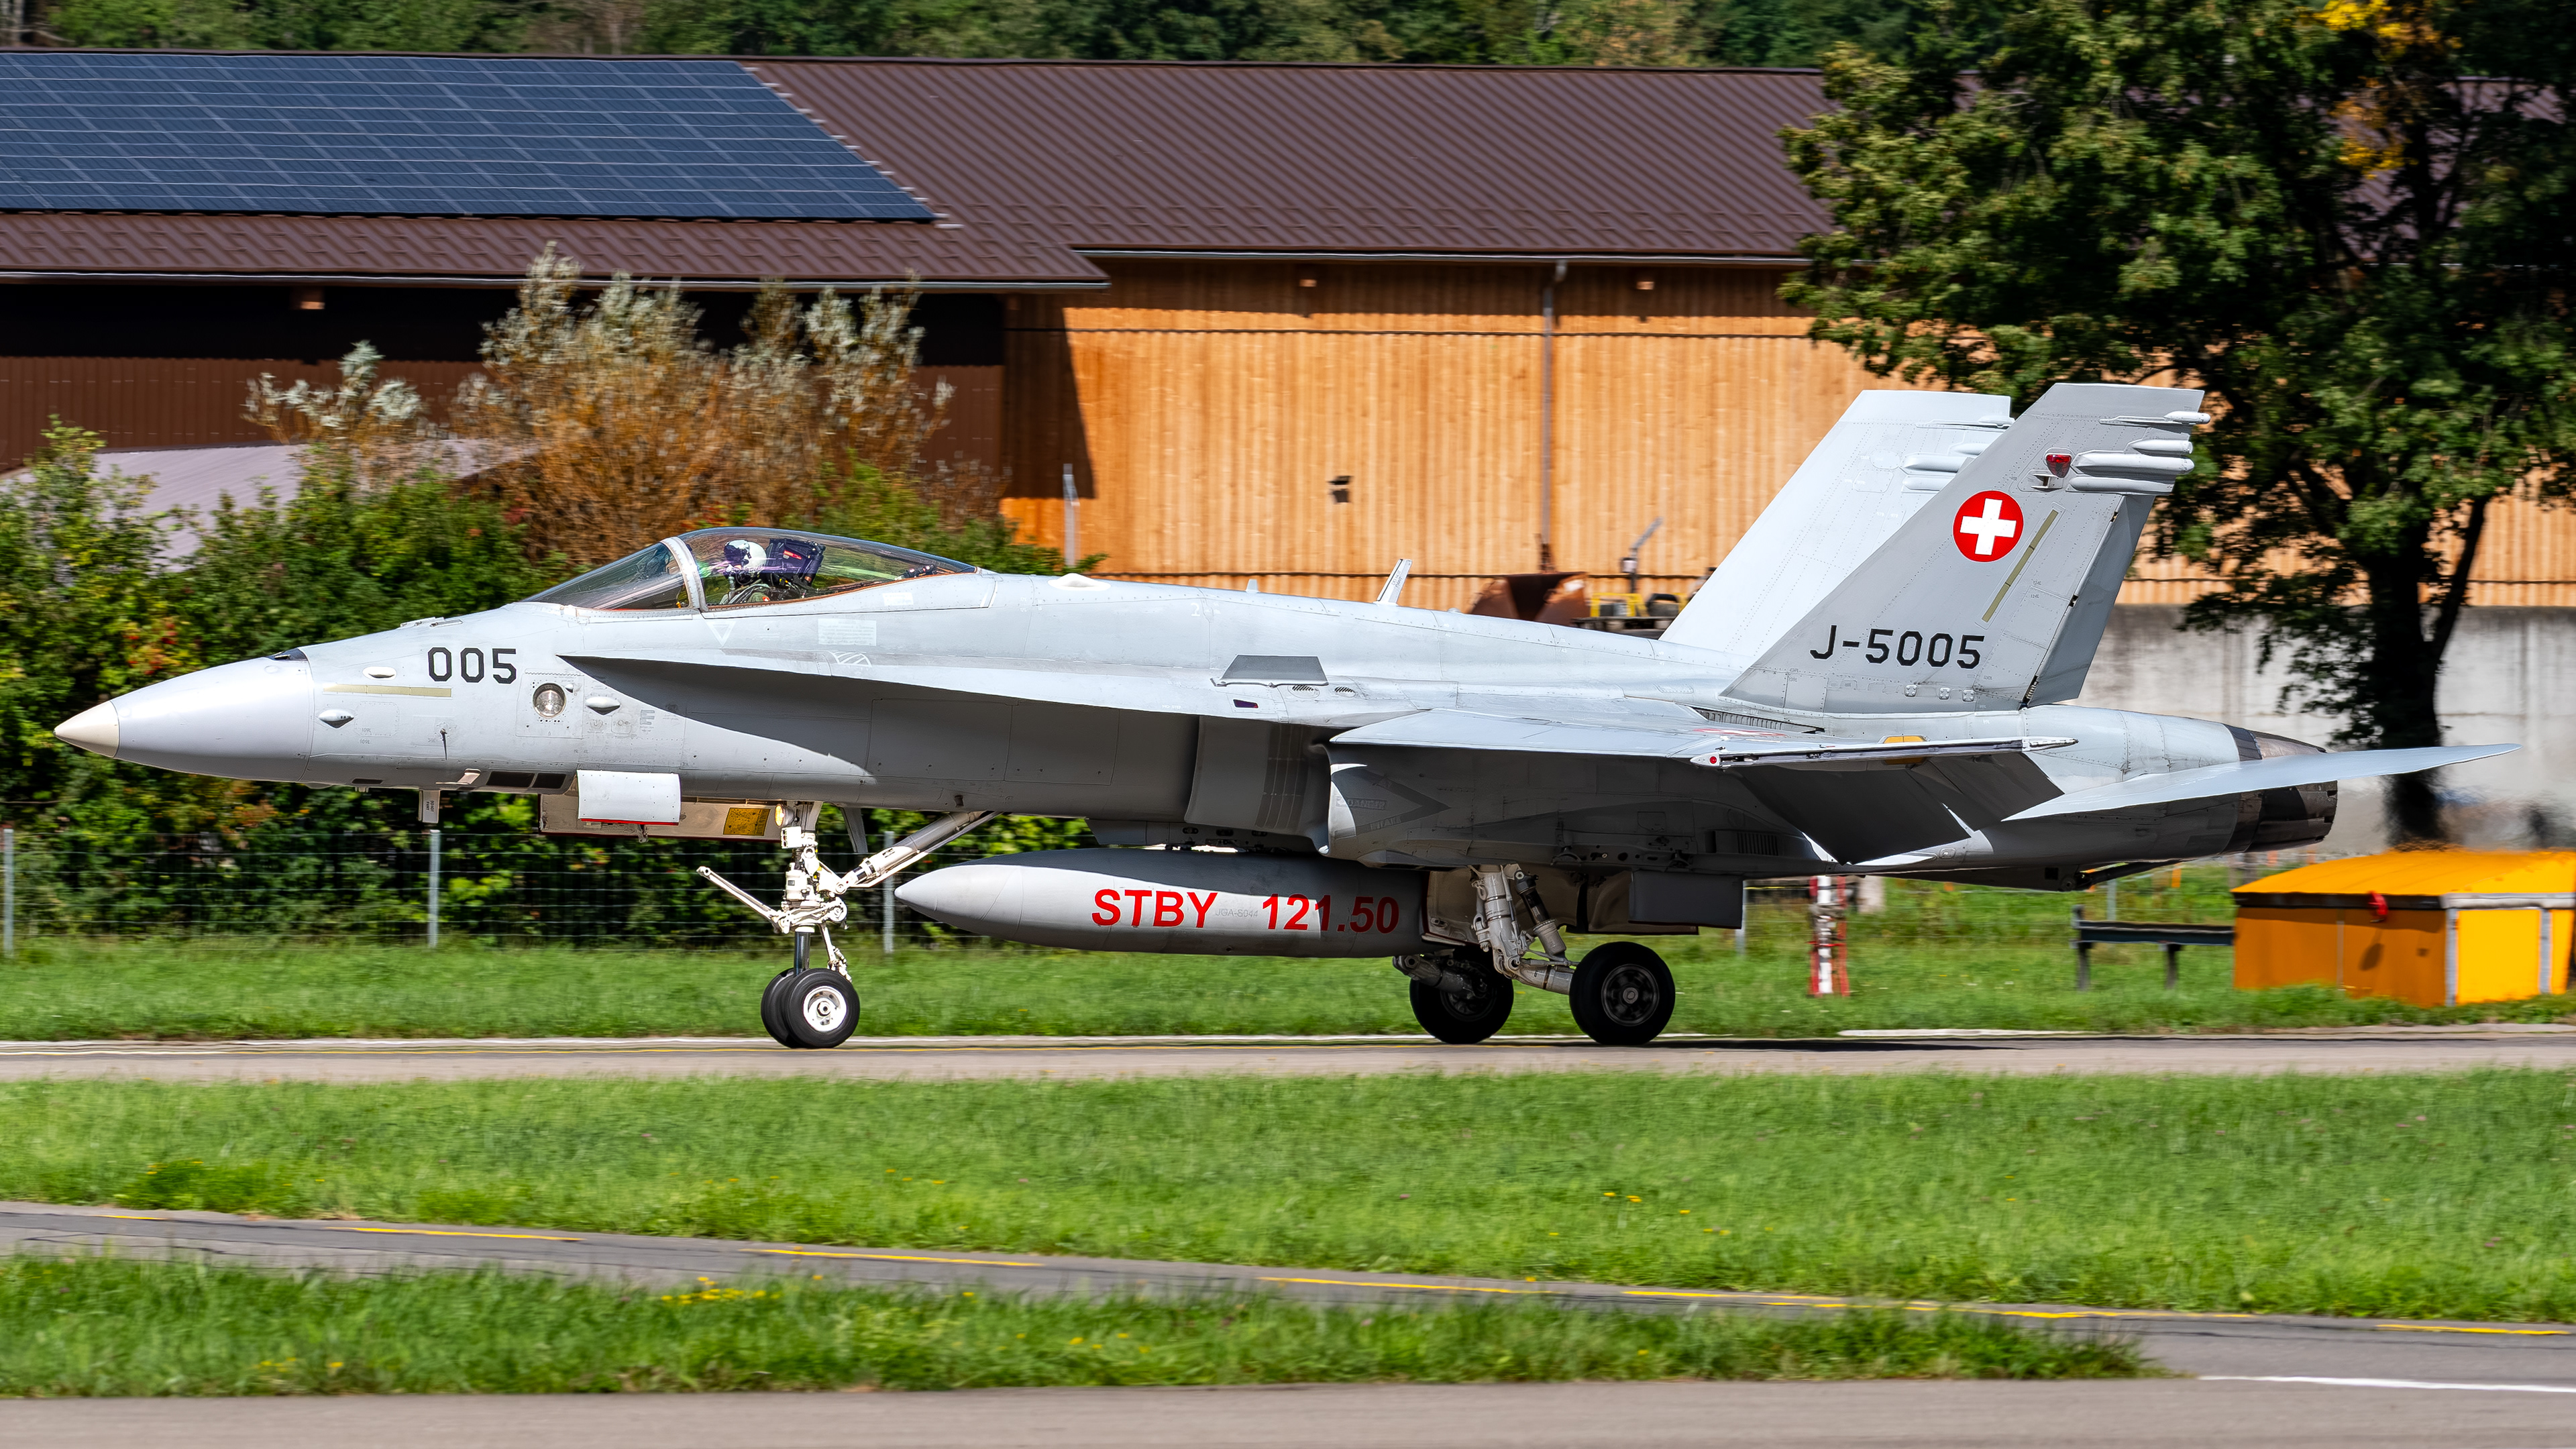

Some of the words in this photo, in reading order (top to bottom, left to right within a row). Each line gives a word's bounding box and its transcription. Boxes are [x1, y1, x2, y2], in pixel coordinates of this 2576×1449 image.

[1191, 602, 1201, 616] 2
[427, 647, 517, 684] 005
[1809, 625, 1986, 669] J-5005
[1091, 889, 1218, 928] STBY
[1261, 894, 1399, 934] 121.50
